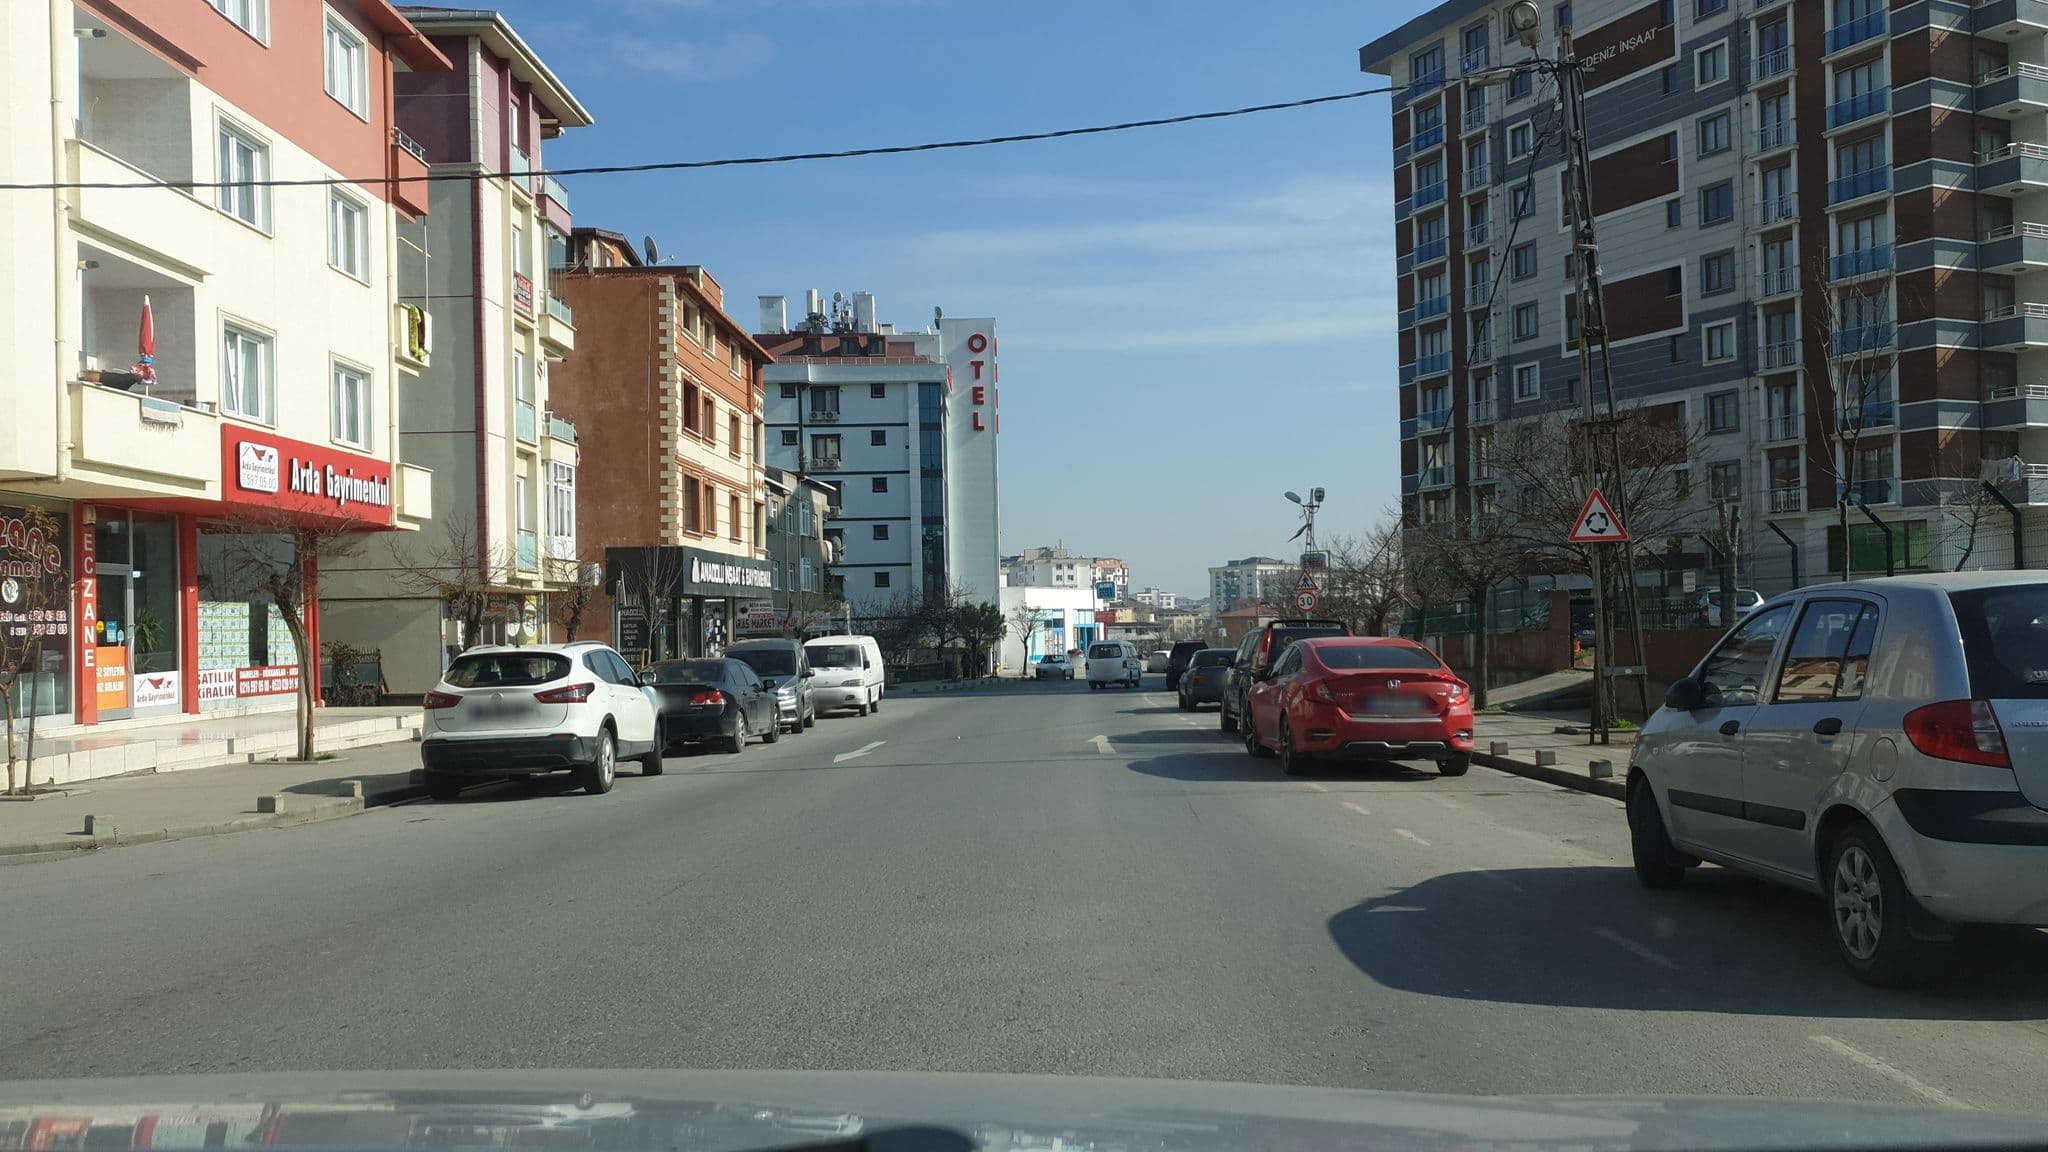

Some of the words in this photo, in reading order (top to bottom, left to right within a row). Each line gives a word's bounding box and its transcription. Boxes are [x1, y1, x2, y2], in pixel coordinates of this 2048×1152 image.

[967, 333, 988, 432] OTEL
[291, 457, 320, 494] Arda
[326, 464, 389, 505] Gayrimenkul
[701, 561, 724, 584] ANADOLU
[83, 533, 95, 667] ECZANE
[1300, 596, 1312, 606] 30
